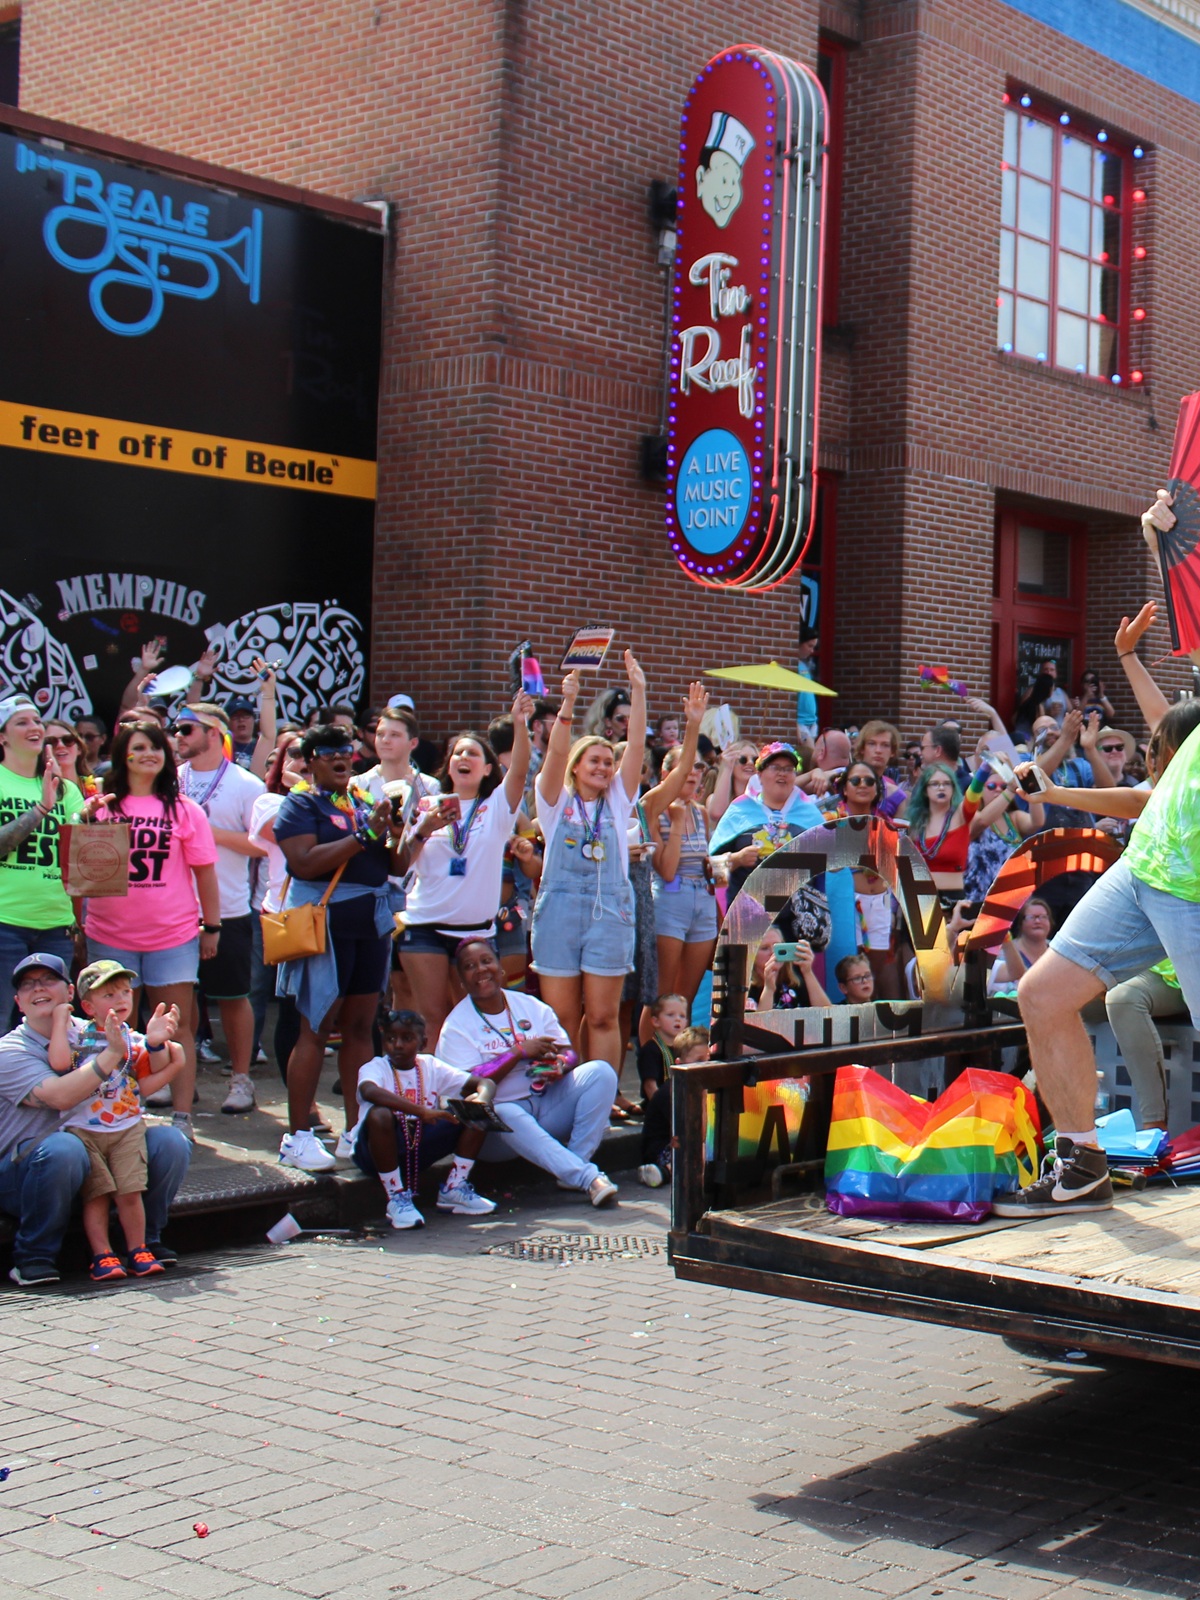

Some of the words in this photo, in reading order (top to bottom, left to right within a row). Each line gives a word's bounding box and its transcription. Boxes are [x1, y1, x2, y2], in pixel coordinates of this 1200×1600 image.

[52, 158, 210, 238] BEALE
[689, 252, 752, 322] Tin
[678, 323, 758, 419] Roof
[19, 414, 100, 456] feet
[118, 434, 173, 462] off
[191, 444, 228, 470] of
[687, 456, 700, 476] A
[705, 451, 741, 474] LIVE
[684, 478, 742, 503] MUSIC
[686, 505, 740, 530] JOINT
[56, 572, 206, 627] MEMPHIS
[568, 645, 603, 658] PRIDE
